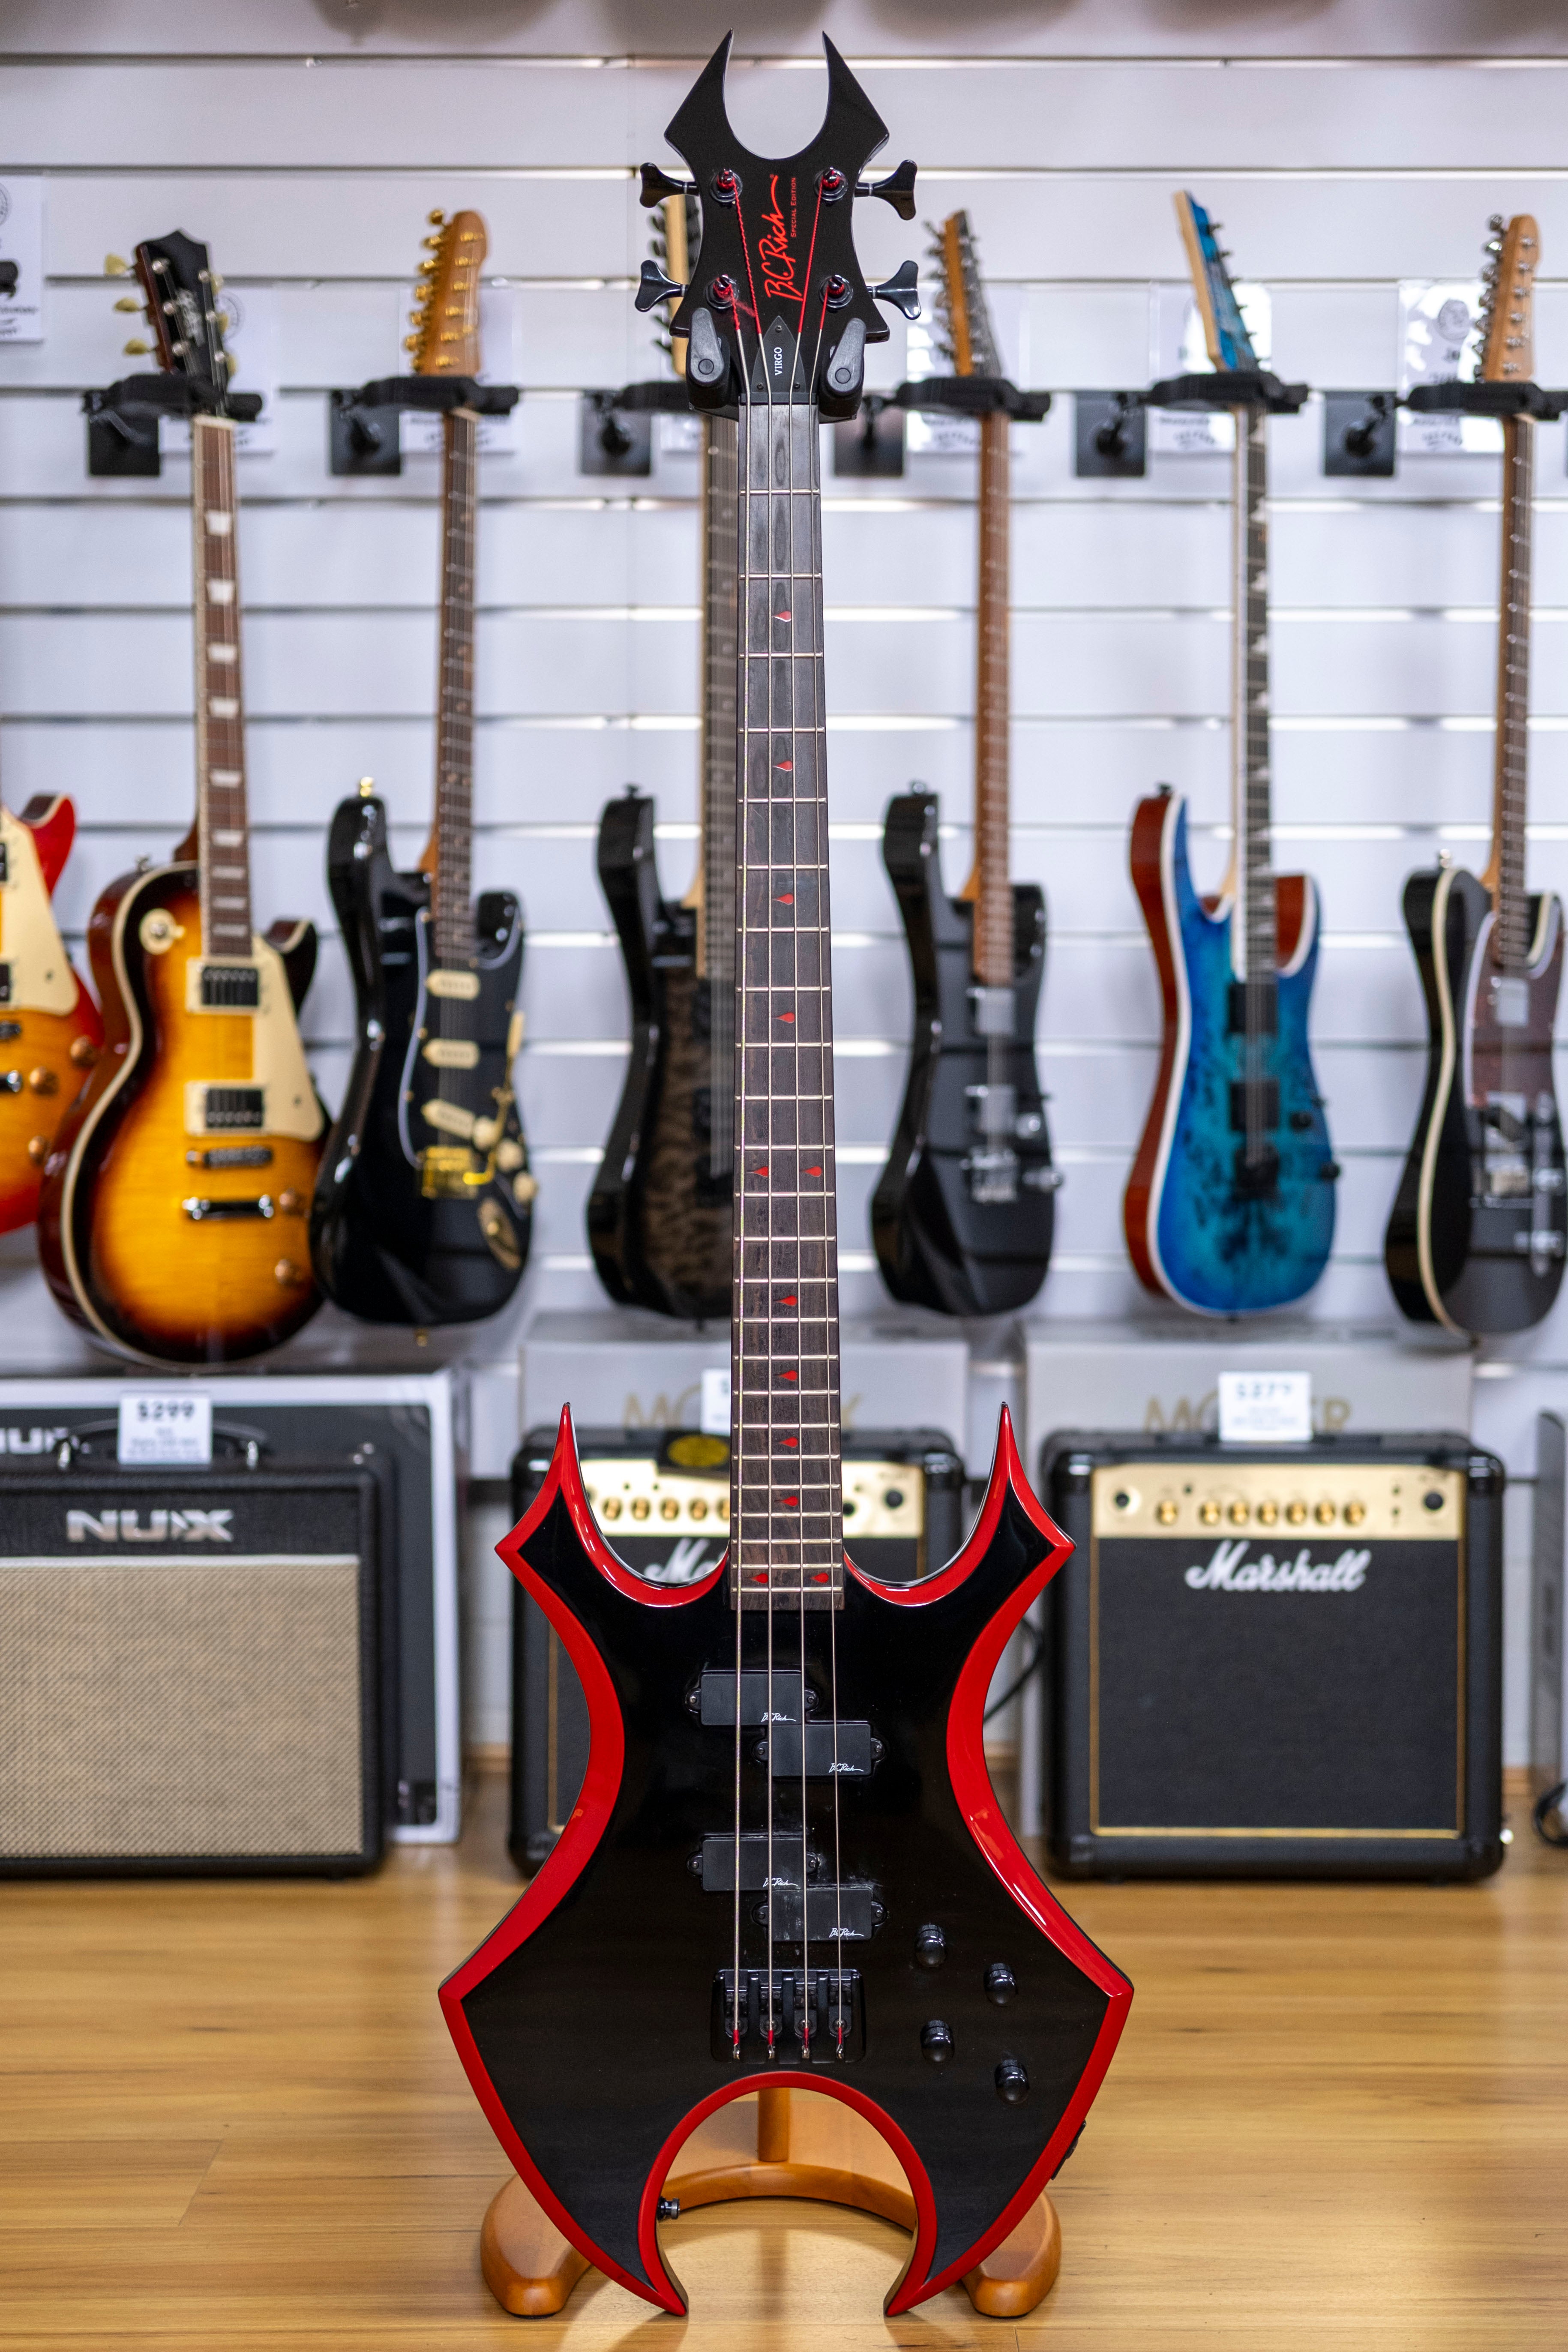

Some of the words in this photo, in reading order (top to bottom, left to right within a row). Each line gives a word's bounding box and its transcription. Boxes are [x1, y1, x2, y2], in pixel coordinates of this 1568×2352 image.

[774, 347, 783, 376] VIRGO
[66, 1509, 234, 1543] NUX
[1184, 1540, 1372, 1592] Marshall
